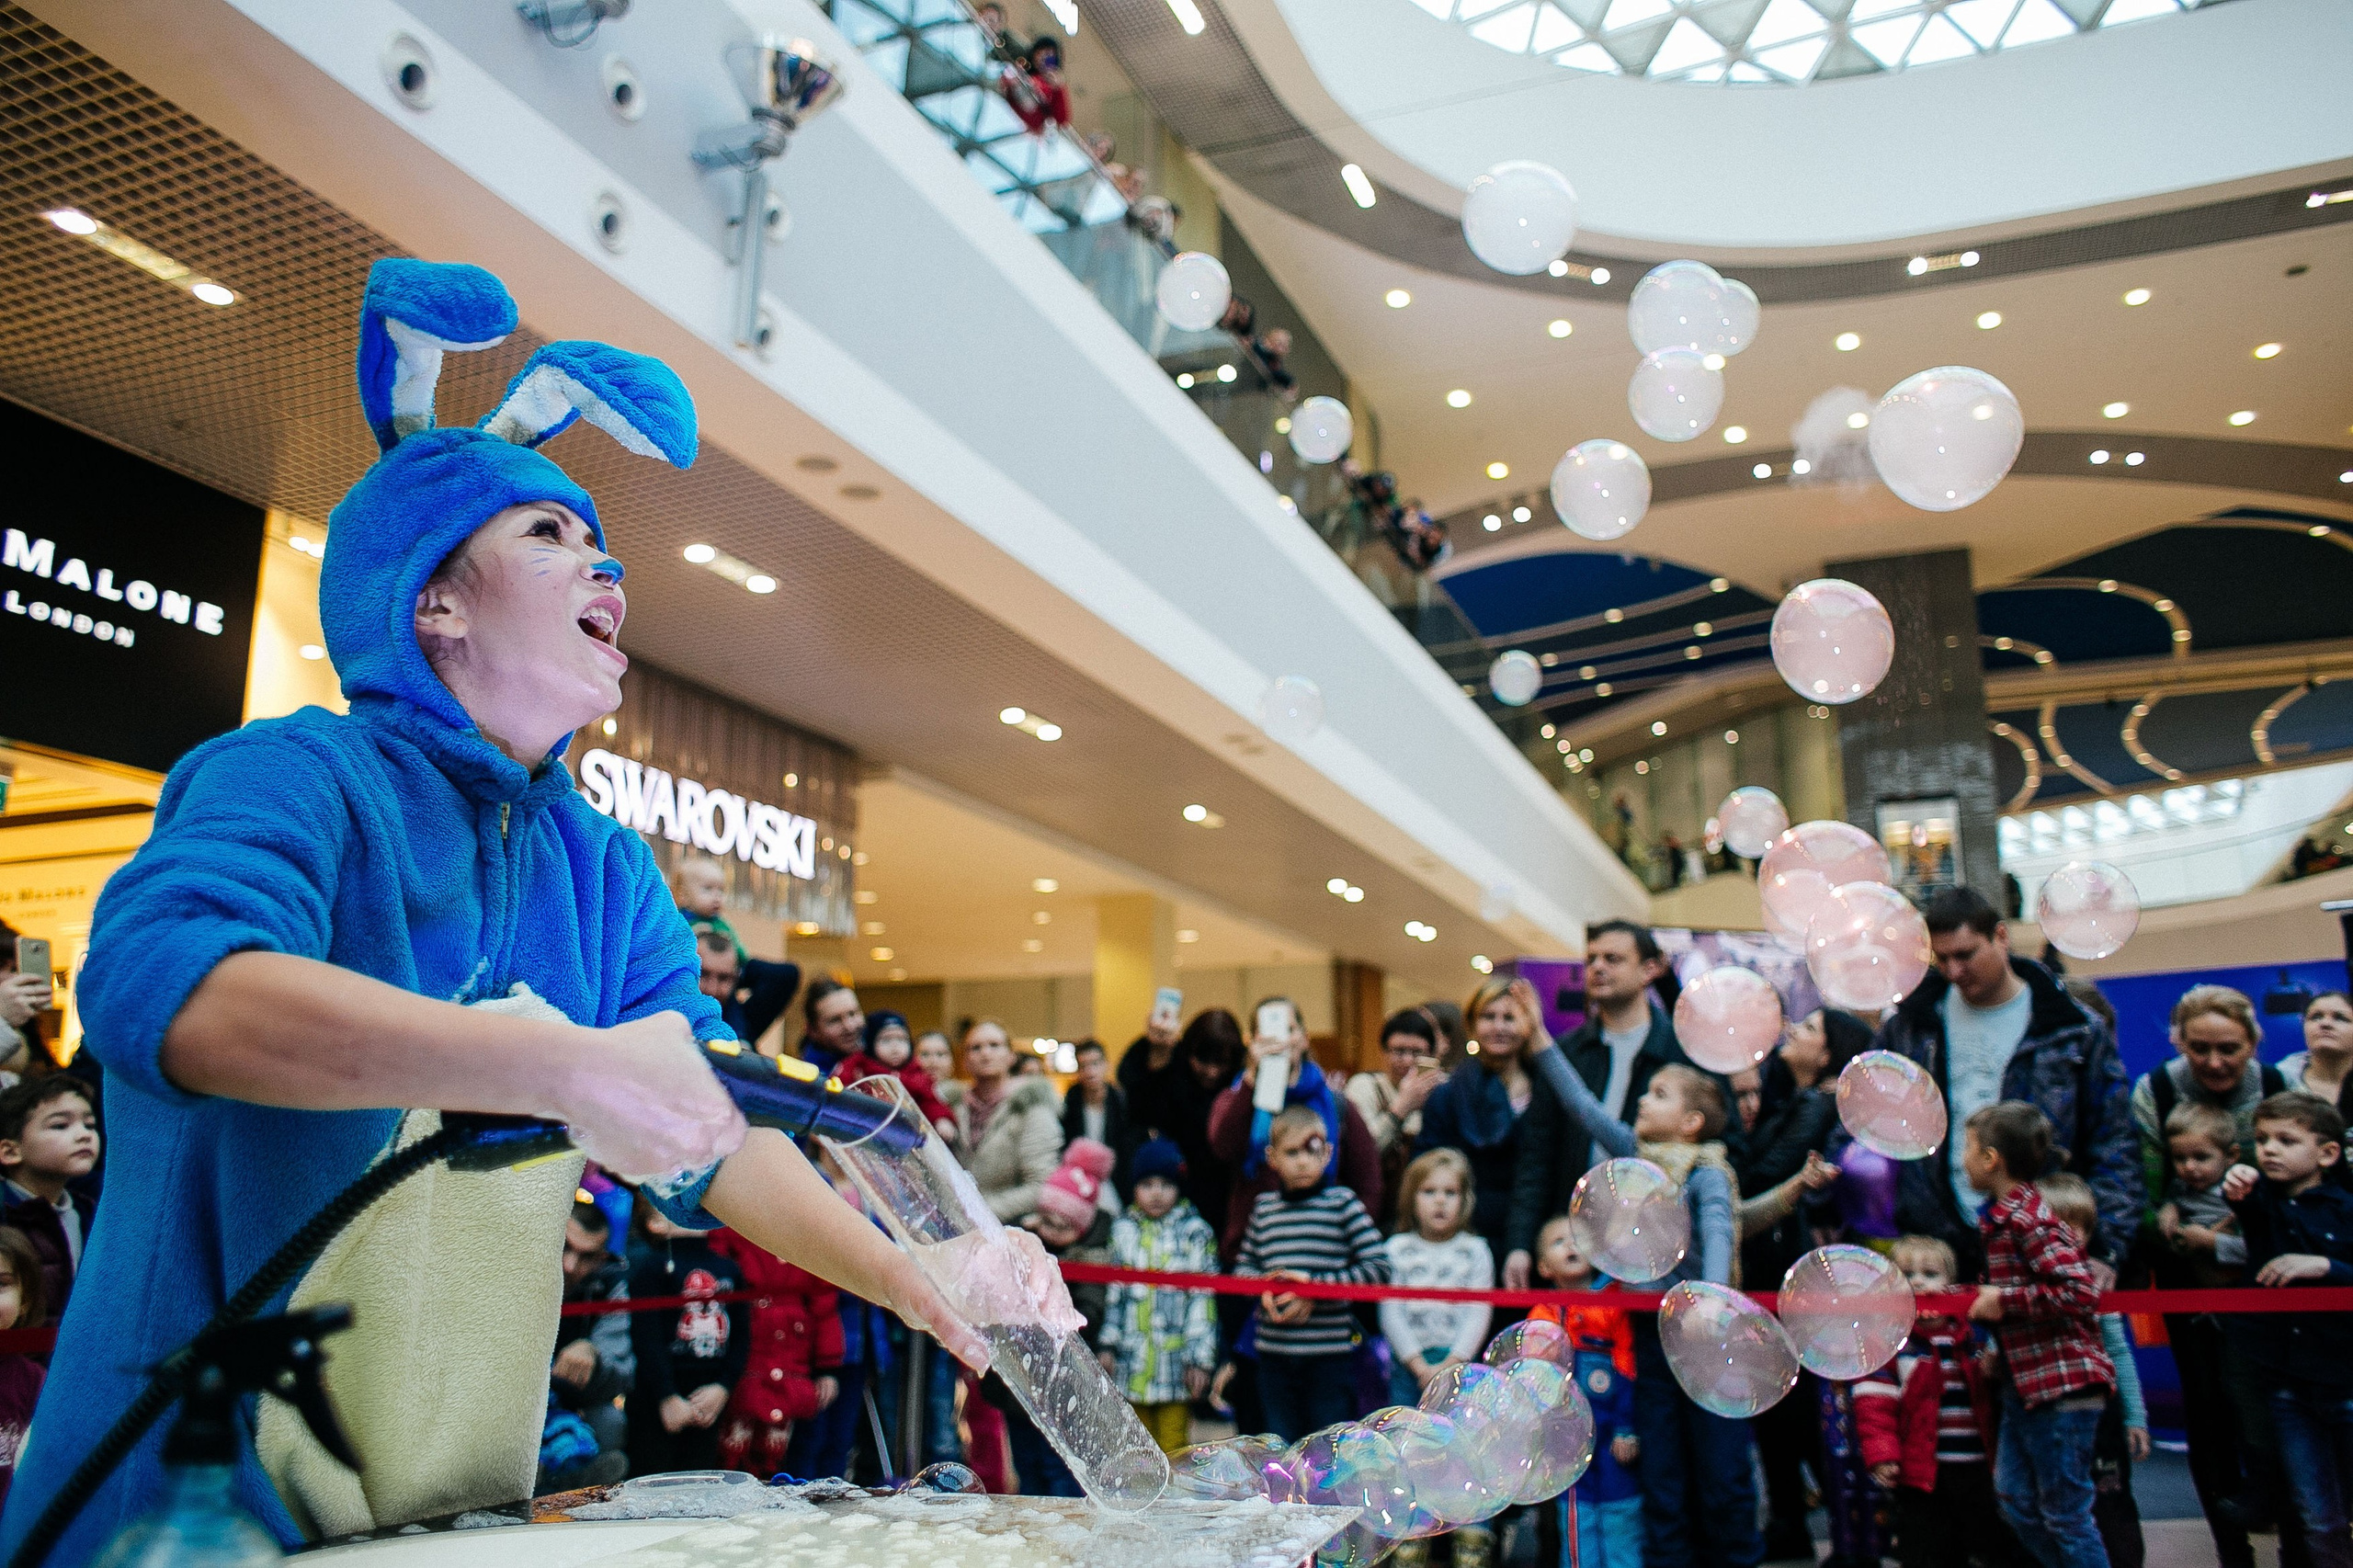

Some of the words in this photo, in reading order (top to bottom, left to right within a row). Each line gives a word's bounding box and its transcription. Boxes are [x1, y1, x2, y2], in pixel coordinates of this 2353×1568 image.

[2, 528, 224, 636] MALONE
[4, 589, 135, 648] LONDON
[579, 747, 817, 881] SWAROVSKI
